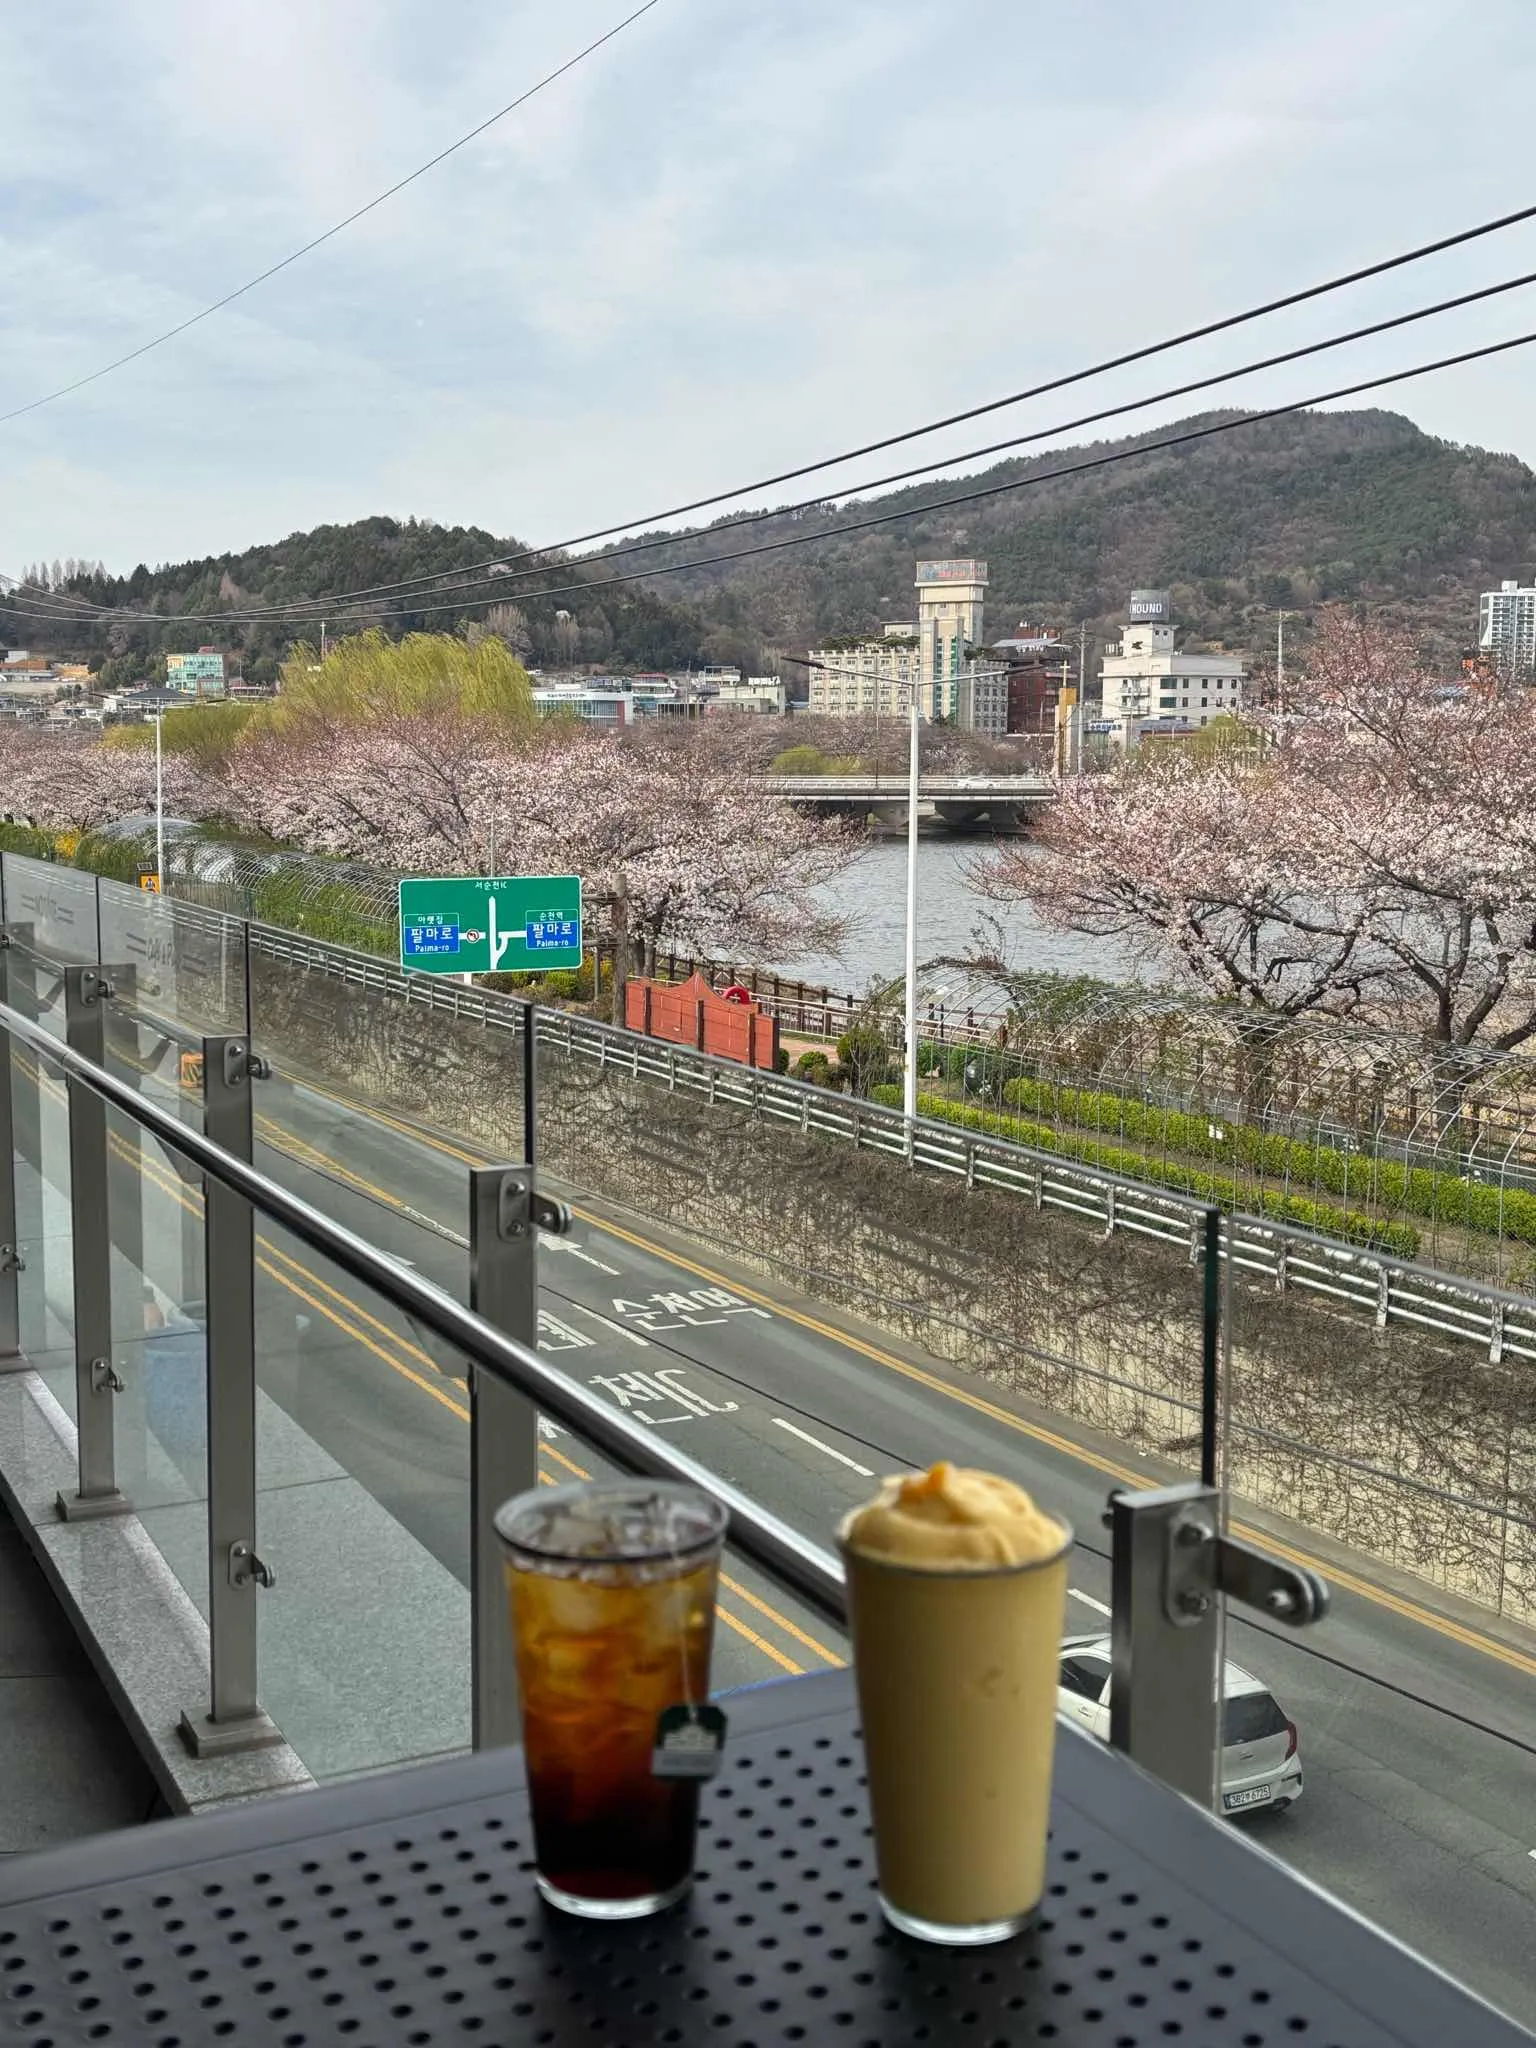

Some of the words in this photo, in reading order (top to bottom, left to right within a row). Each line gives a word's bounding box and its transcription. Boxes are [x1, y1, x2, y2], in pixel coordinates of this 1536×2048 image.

[539, 911, 563, 921] 순천역
[411, 927, 454, 944] 팔마로
[532, 922, 573, 939] 팔마로
[415, 944, 450, 953] Palma-ro
[536, 939, 569, 948] Palma-ro
[611, 1287, 773, 1331] 순천역
